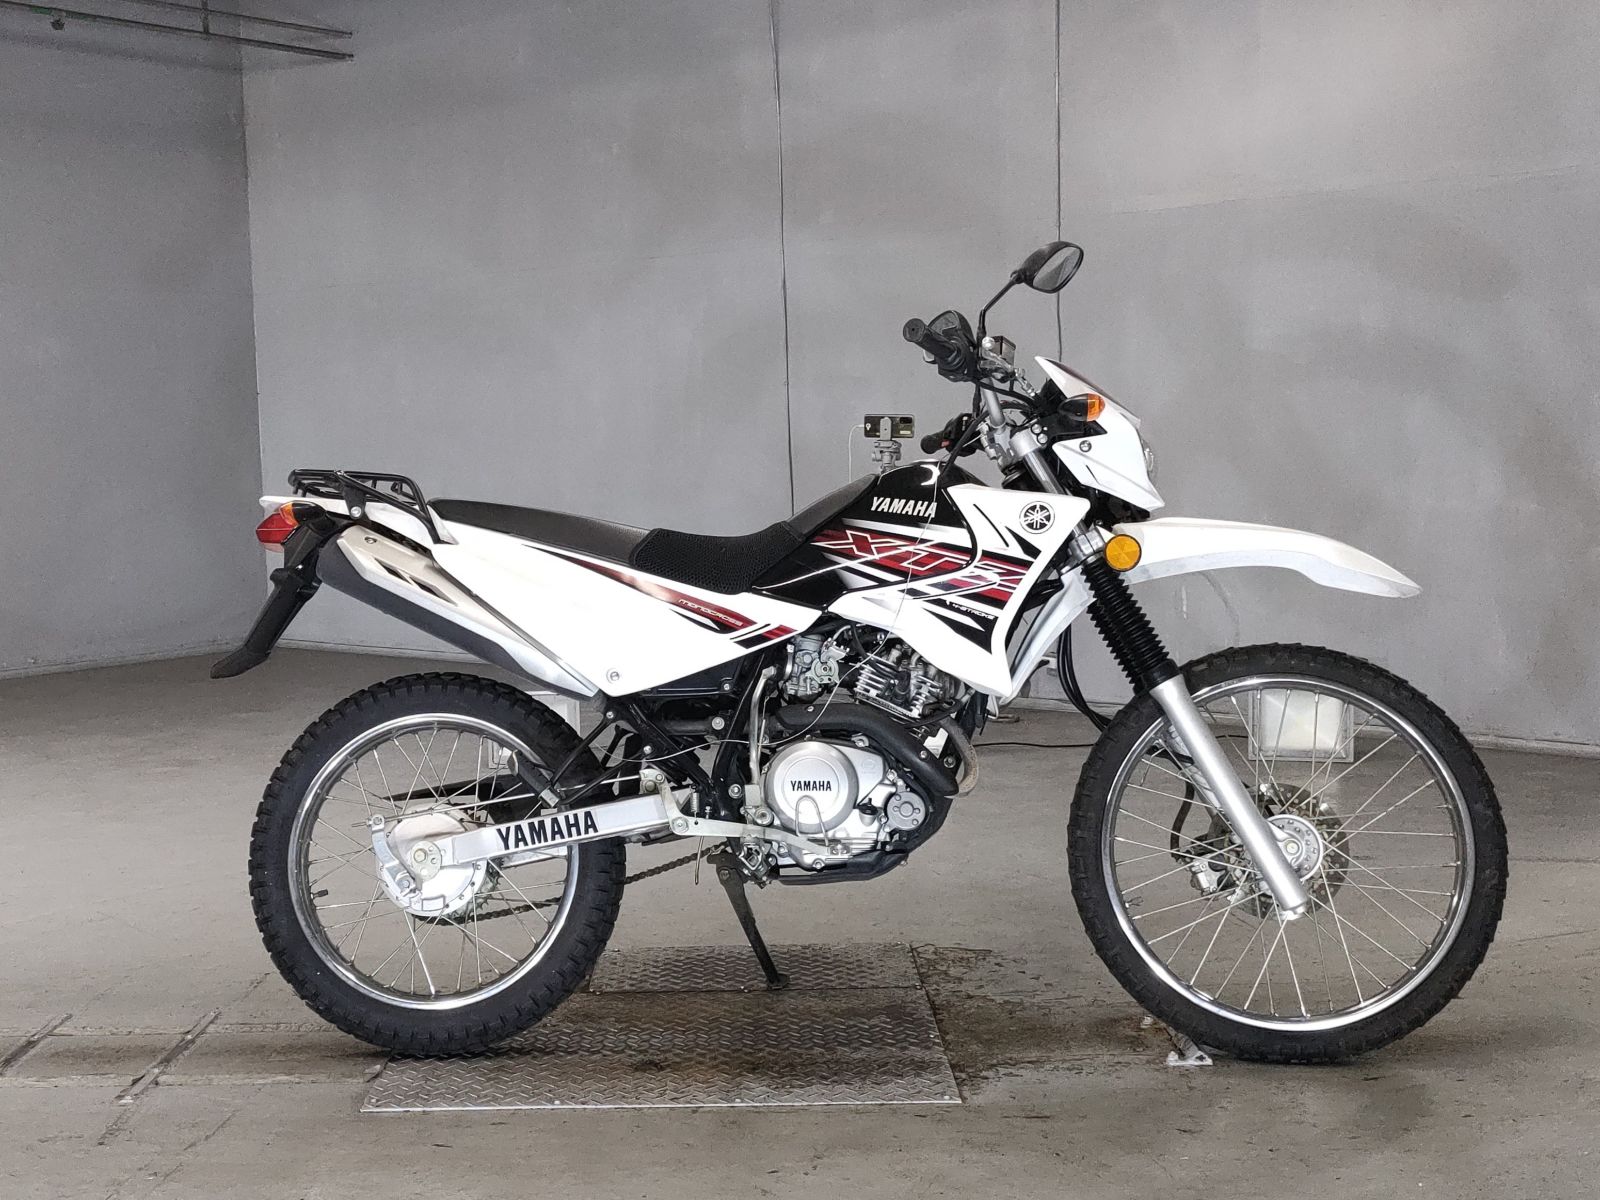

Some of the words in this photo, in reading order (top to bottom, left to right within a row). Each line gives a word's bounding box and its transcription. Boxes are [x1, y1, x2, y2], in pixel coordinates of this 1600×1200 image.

[870, 496, 938, 518] YAMAHA
[790, 780, 832, 792] YAMAHA
[496, 810, 599, 851] YAMAHA
